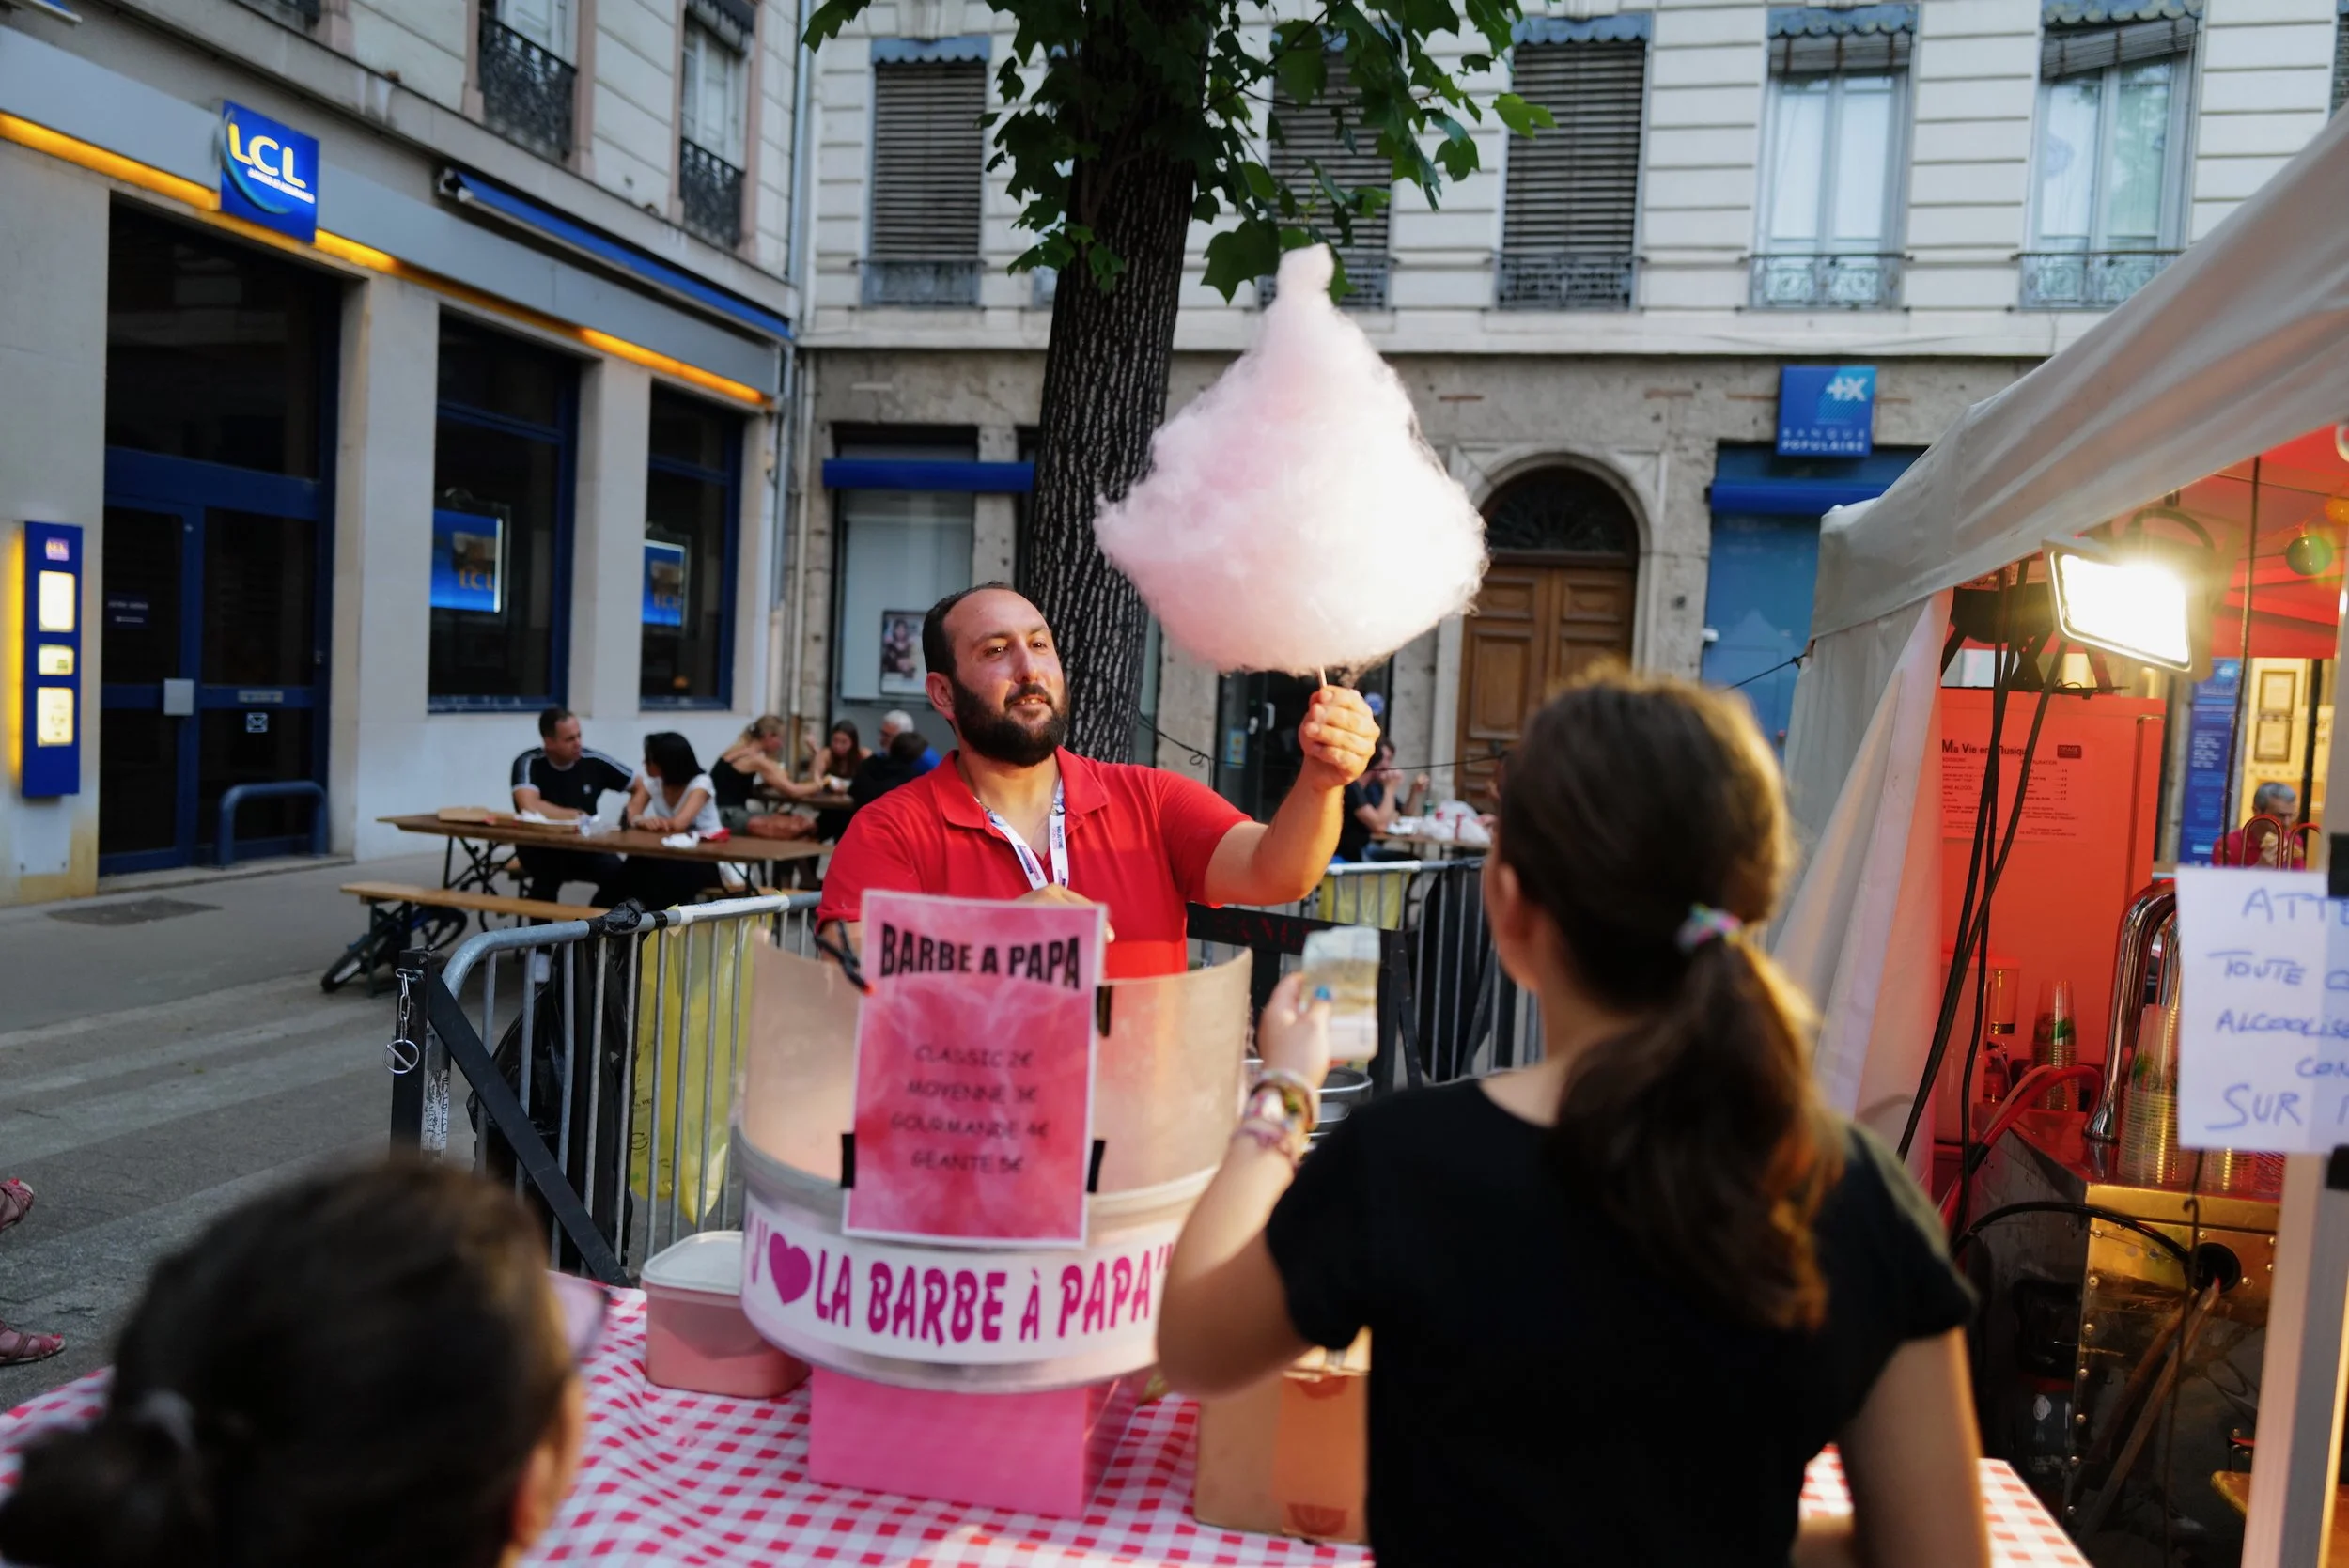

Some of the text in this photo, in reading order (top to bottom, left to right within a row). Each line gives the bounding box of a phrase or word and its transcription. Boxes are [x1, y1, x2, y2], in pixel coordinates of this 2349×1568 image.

[228, 123, 307, 189] LCL
[879, 920, 1081, 991] BARBE A PAPA
[2206, 950, 2307, 987] TOUTE
[2204, 1083, 2303, 1131] SUR
[815, 1248, 851, 1328] LA
[867, 1261, 1008, 1347] BARBE
[1019, 1268, 1040, 1343] À
